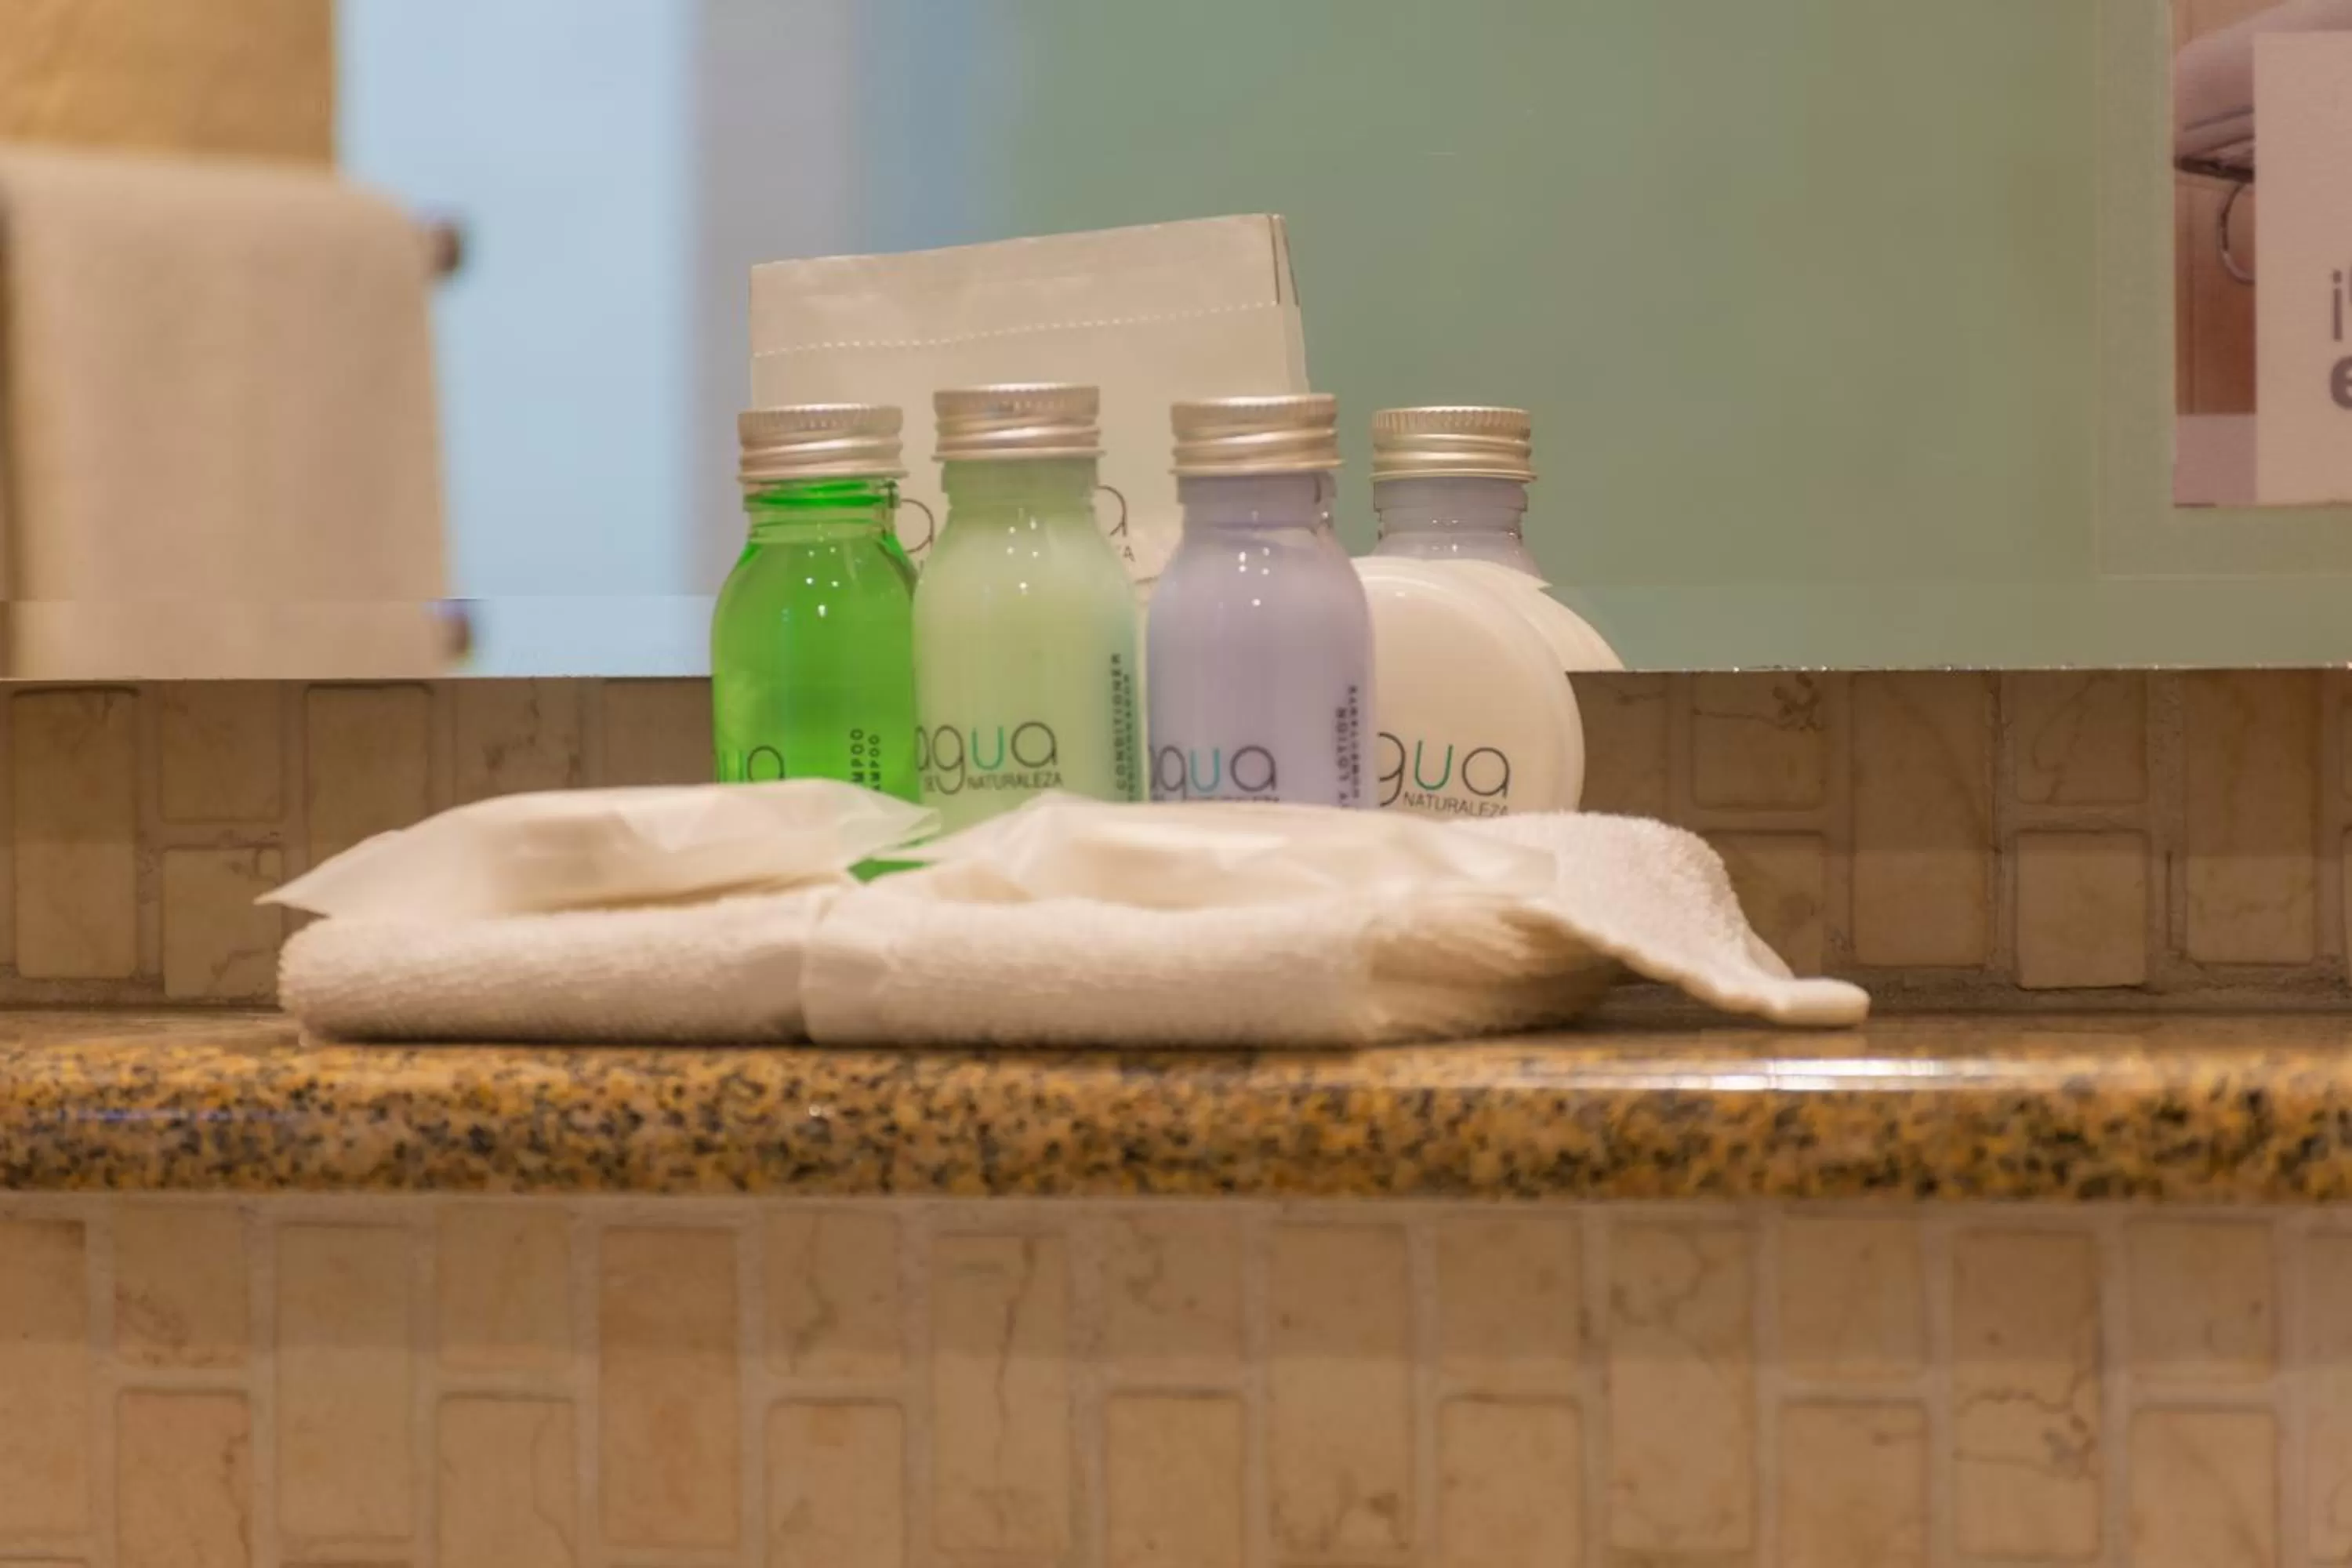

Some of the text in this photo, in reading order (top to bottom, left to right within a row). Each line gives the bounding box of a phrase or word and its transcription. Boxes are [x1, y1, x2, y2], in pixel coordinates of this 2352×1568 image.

[850, 728, 864, 783] MPOO
[1335, 706, 1350, 782] LOTION
[967, 771, 1063, 791] NATURALEZA
[1402, 791, 1508, 817] NATURALEZA
